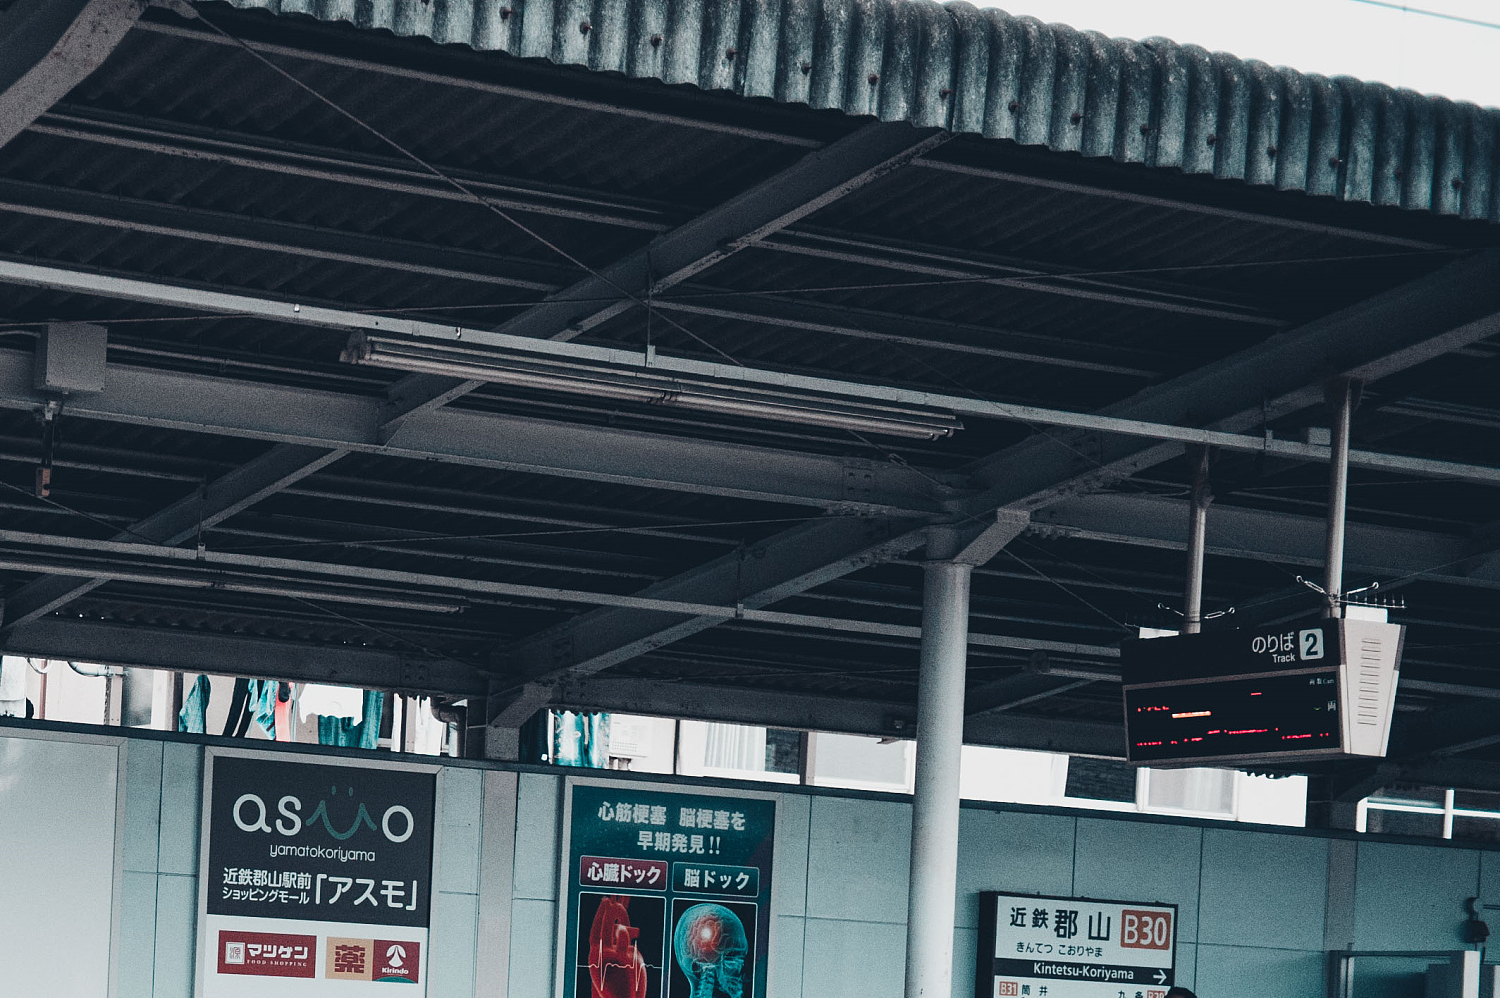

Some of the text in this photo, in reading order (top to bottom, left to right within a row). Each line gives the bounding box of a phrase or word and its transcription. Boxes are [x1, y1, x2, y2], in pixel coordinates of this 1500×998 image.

[1252, 631, 1295, 654] のりば
[1304, 632, 1319, 656] 2
[1272, 653, 1296, 663] Track
[597, 800, 746, 832] 心筋梗塞 脳梗塞を
[269, 842, 376, 863] yamatokoriyama
[222, 867, 312, 890] 近鉄郡山駅前
[587, 861, 662, 885] 心臓ドック
[684, 867, 750, 891] 脳ドック
[222, 886, 310, 905] ショッピングモール
[315, 873, 418, 911] 「アスモ」
[1123, 914, 1168, 947] B30
[247, 943, 309, 960] マツゲン
[381, 967, 409, 975] Kirindo
[1033, 962, 1135, 981] Kintetsu-Koriyama
[1000, 982, 1018, 996] B31
[1021, 984, 1049, 997] 筒井
